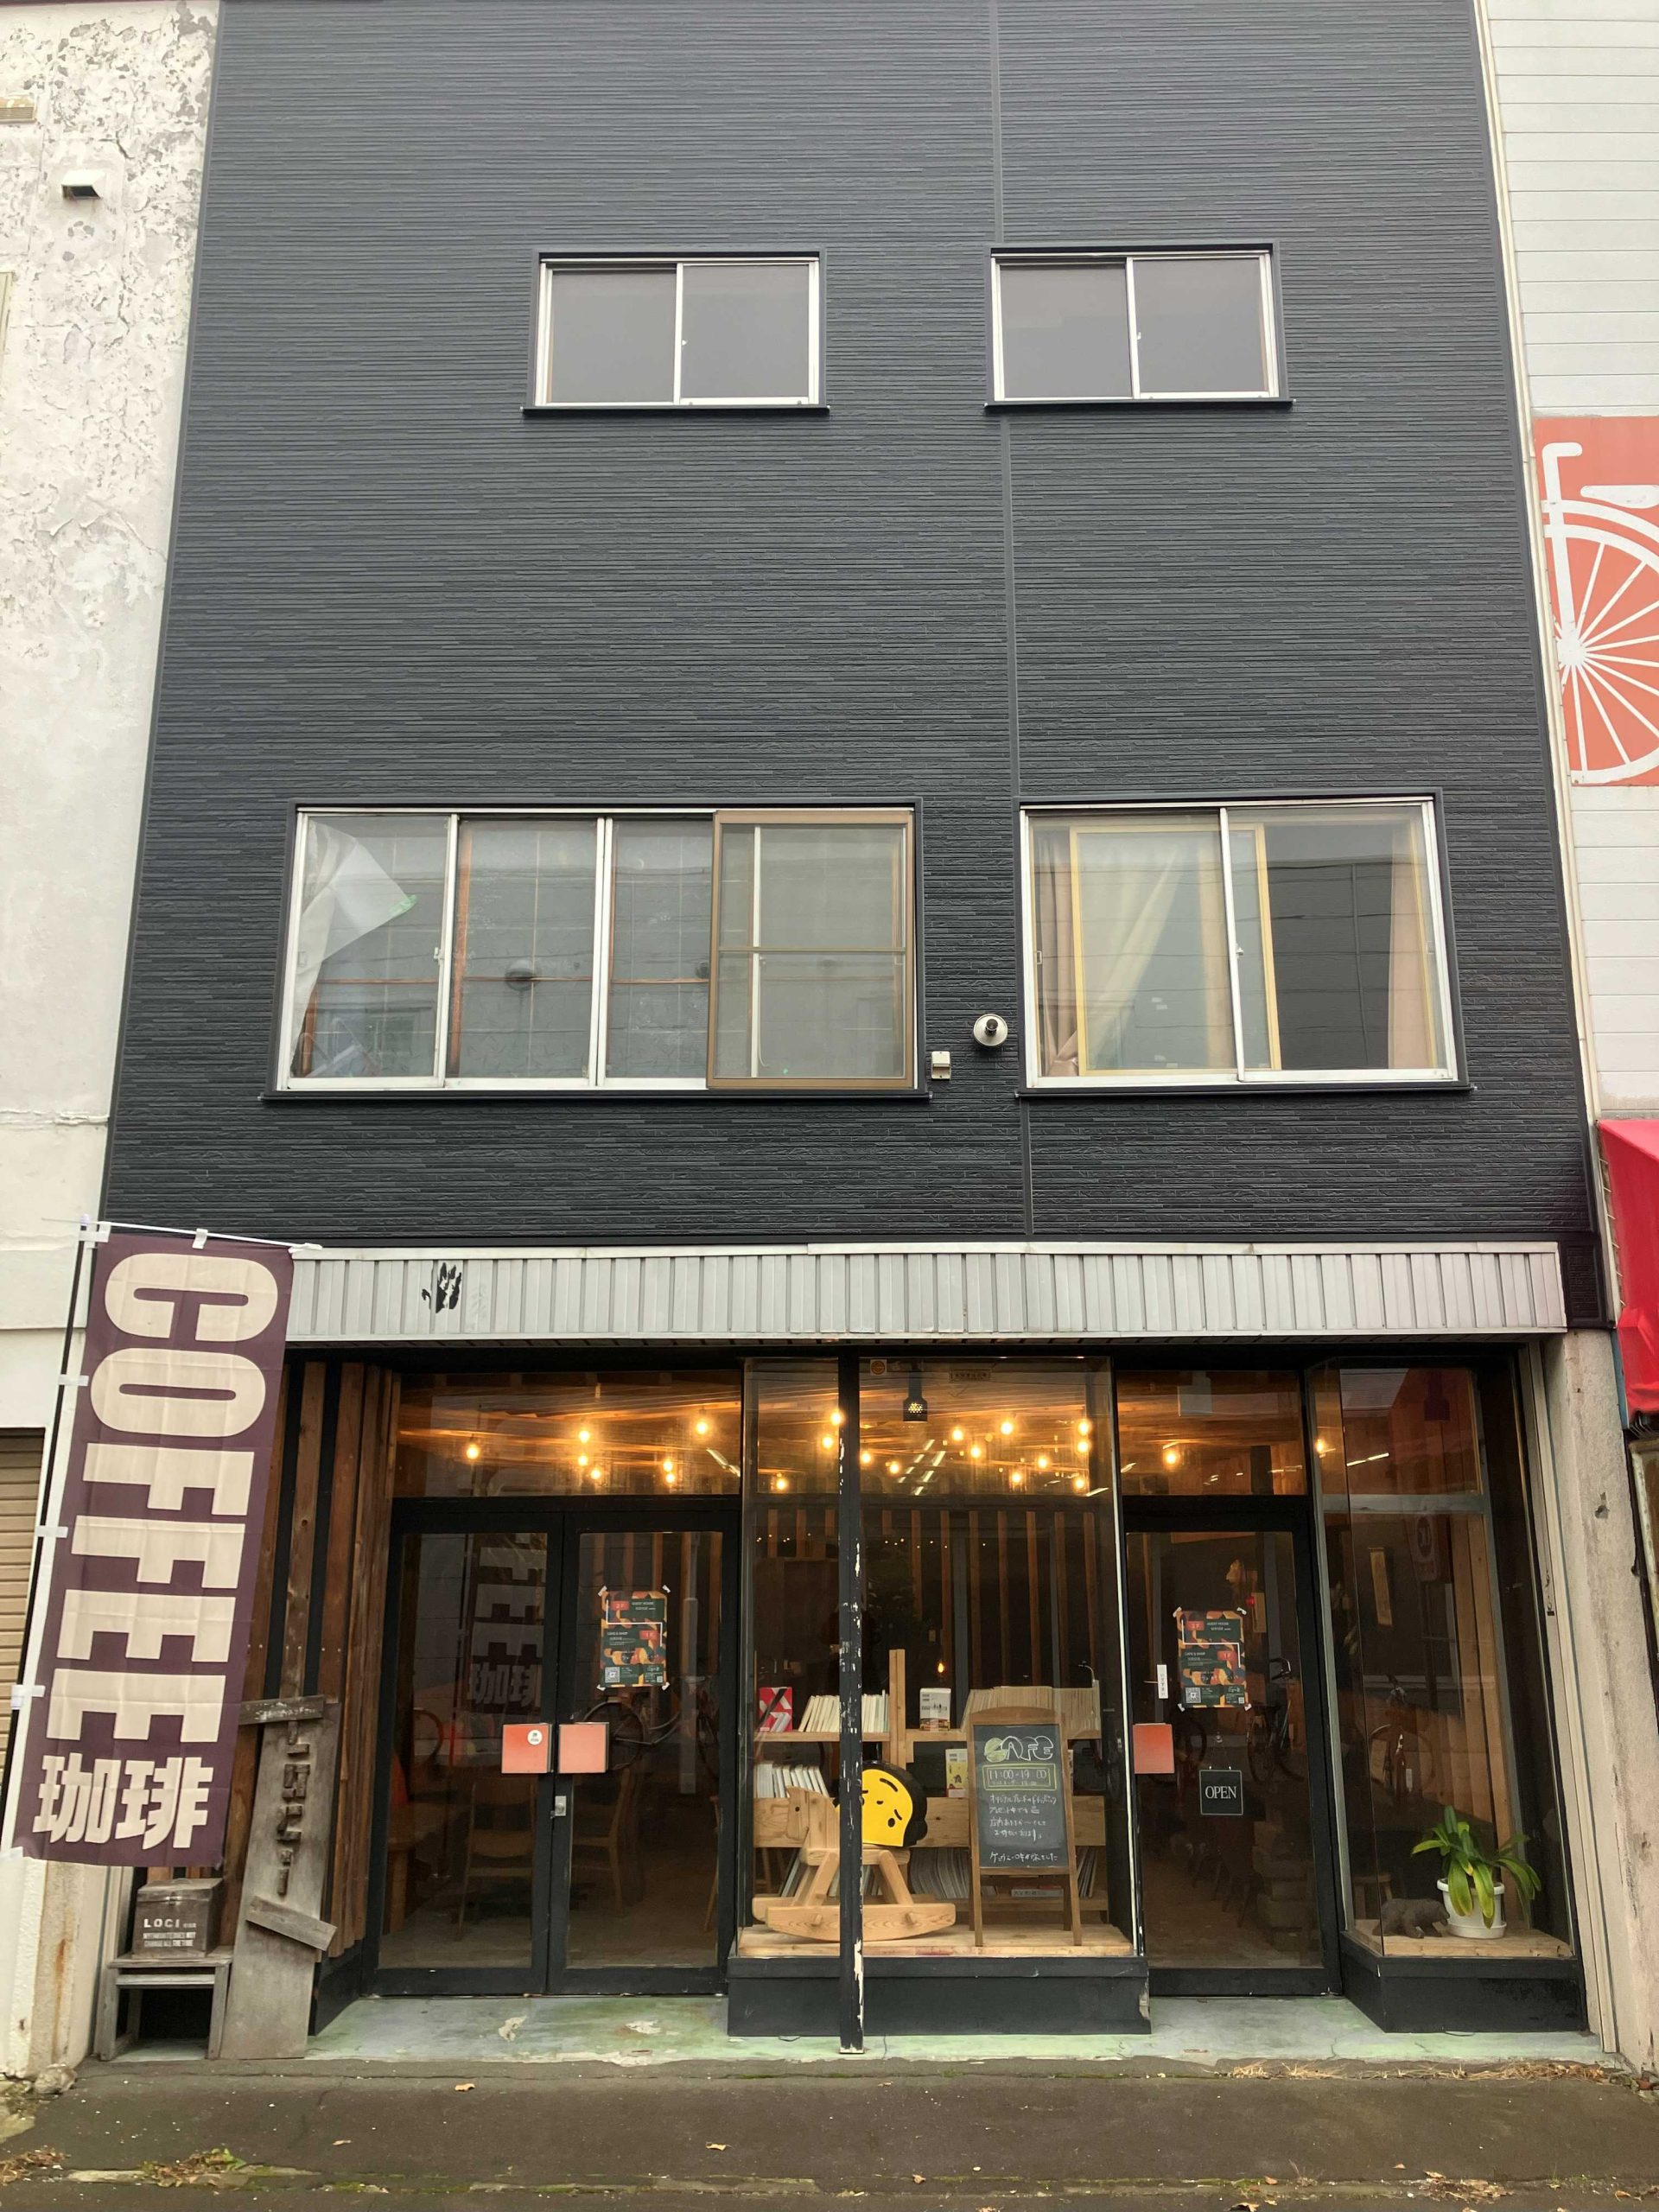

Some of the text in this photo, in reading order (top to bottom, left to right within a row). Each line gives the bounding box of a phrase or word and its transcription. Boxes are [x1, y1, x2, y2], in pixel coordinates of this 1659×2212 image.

[46, 1252, 278, 1743] COFFEE
[984, 1735, 1054, 1763] CAFE
[32, 1754, 213, 1849] 珈琲
[1205, 1785, 1236, 1799] OPEN
[143, 1918, 180, 1929] LOCI
